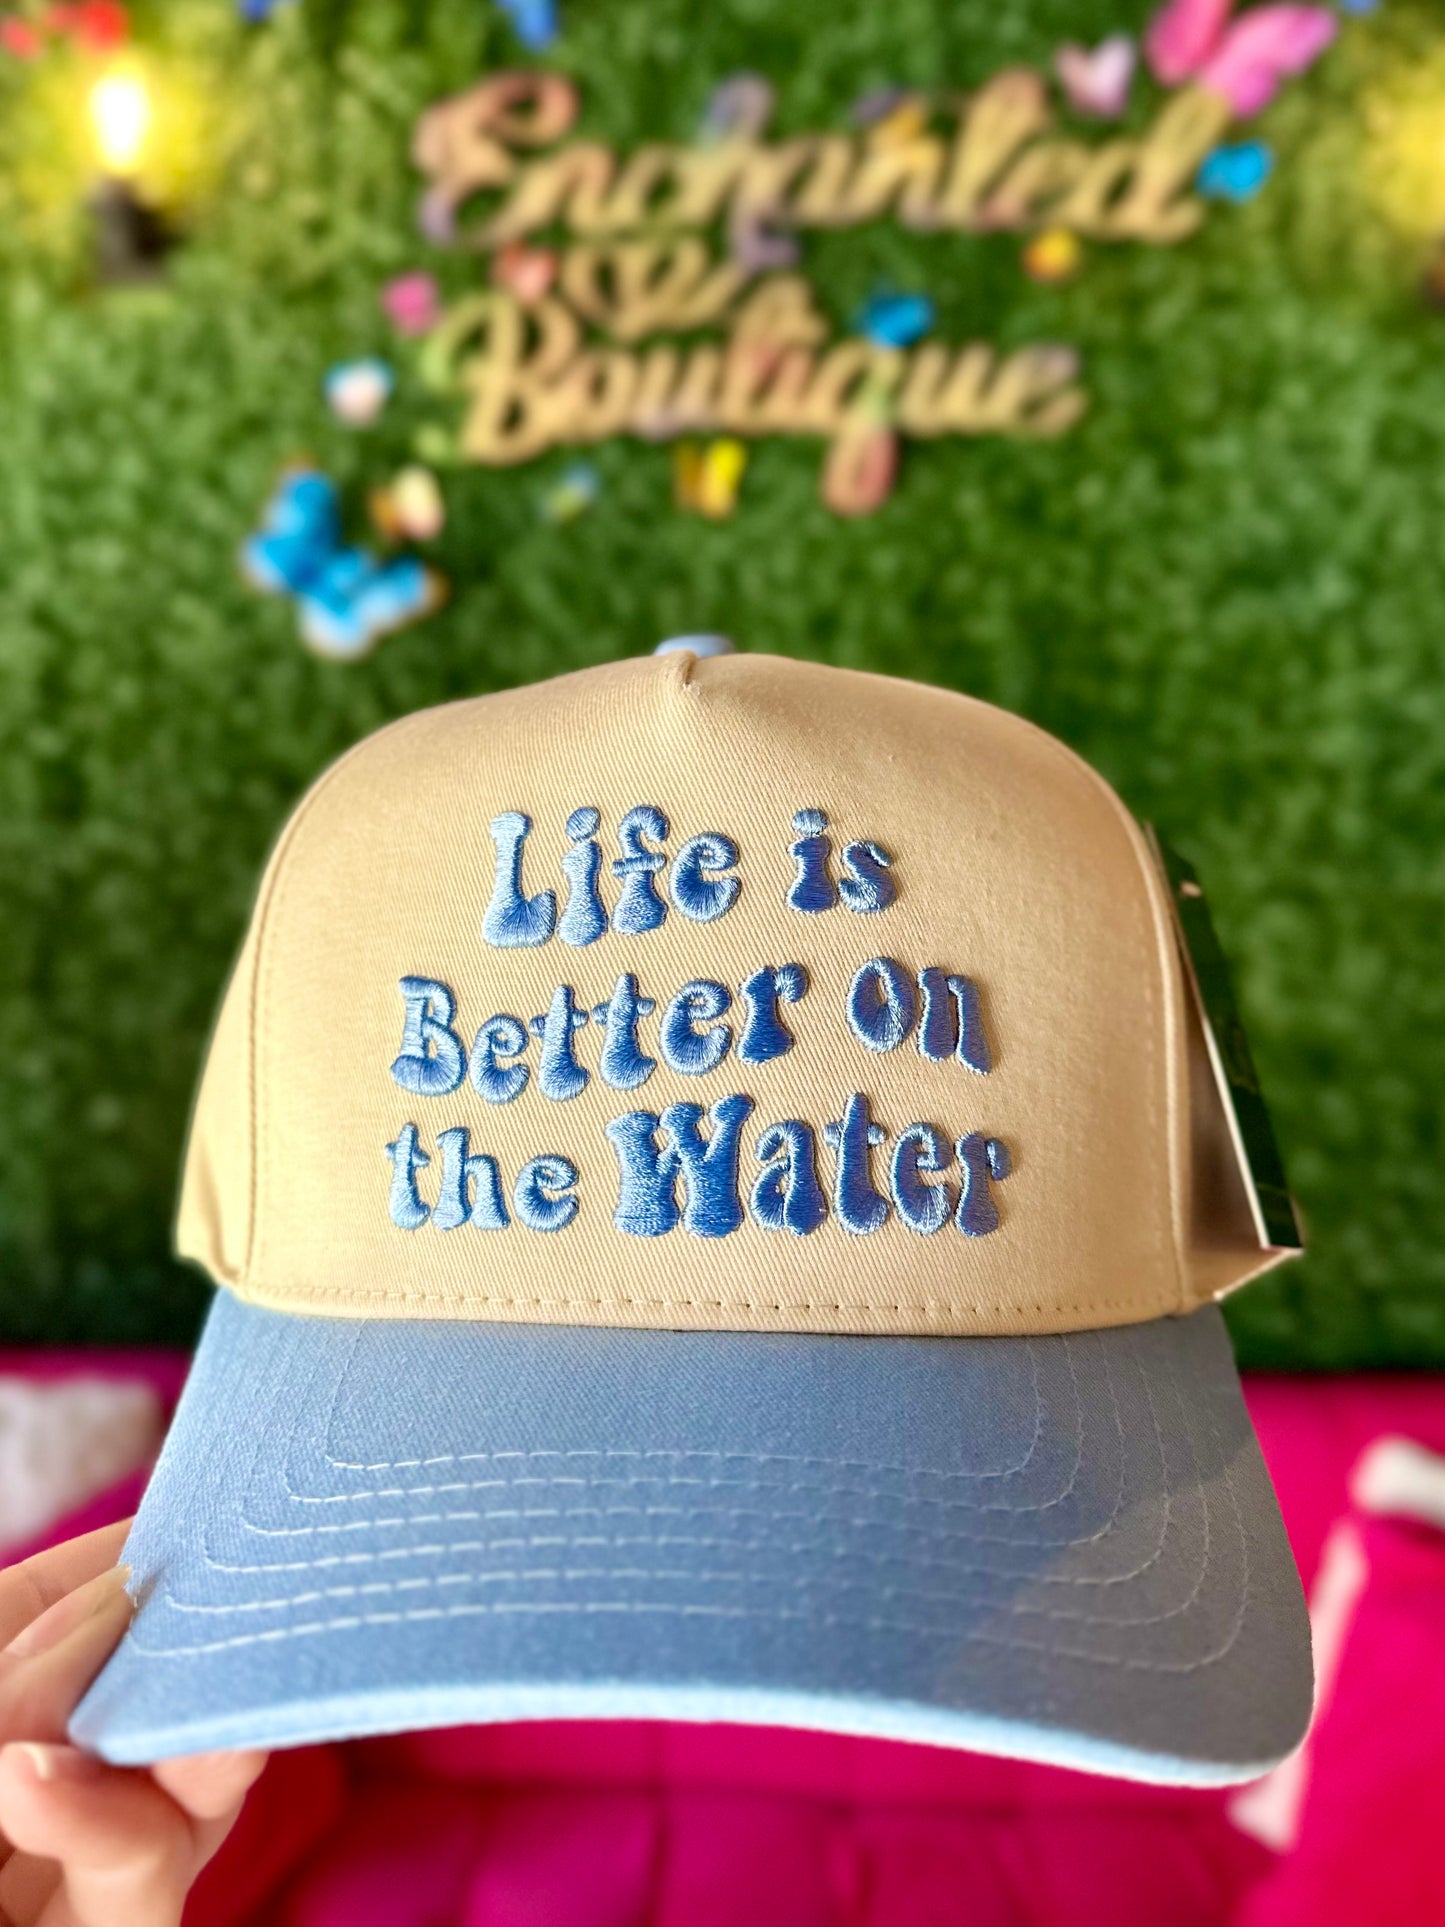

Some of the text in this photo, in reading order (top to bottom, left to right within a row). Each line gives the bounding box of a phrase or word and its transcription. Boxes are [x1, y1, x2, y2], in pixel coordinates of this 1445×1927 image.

[482, 805, 897, 948] Life is
[390, 955, 991, 1104] Better on
[384, 1091, 1012, 1238] the Water
